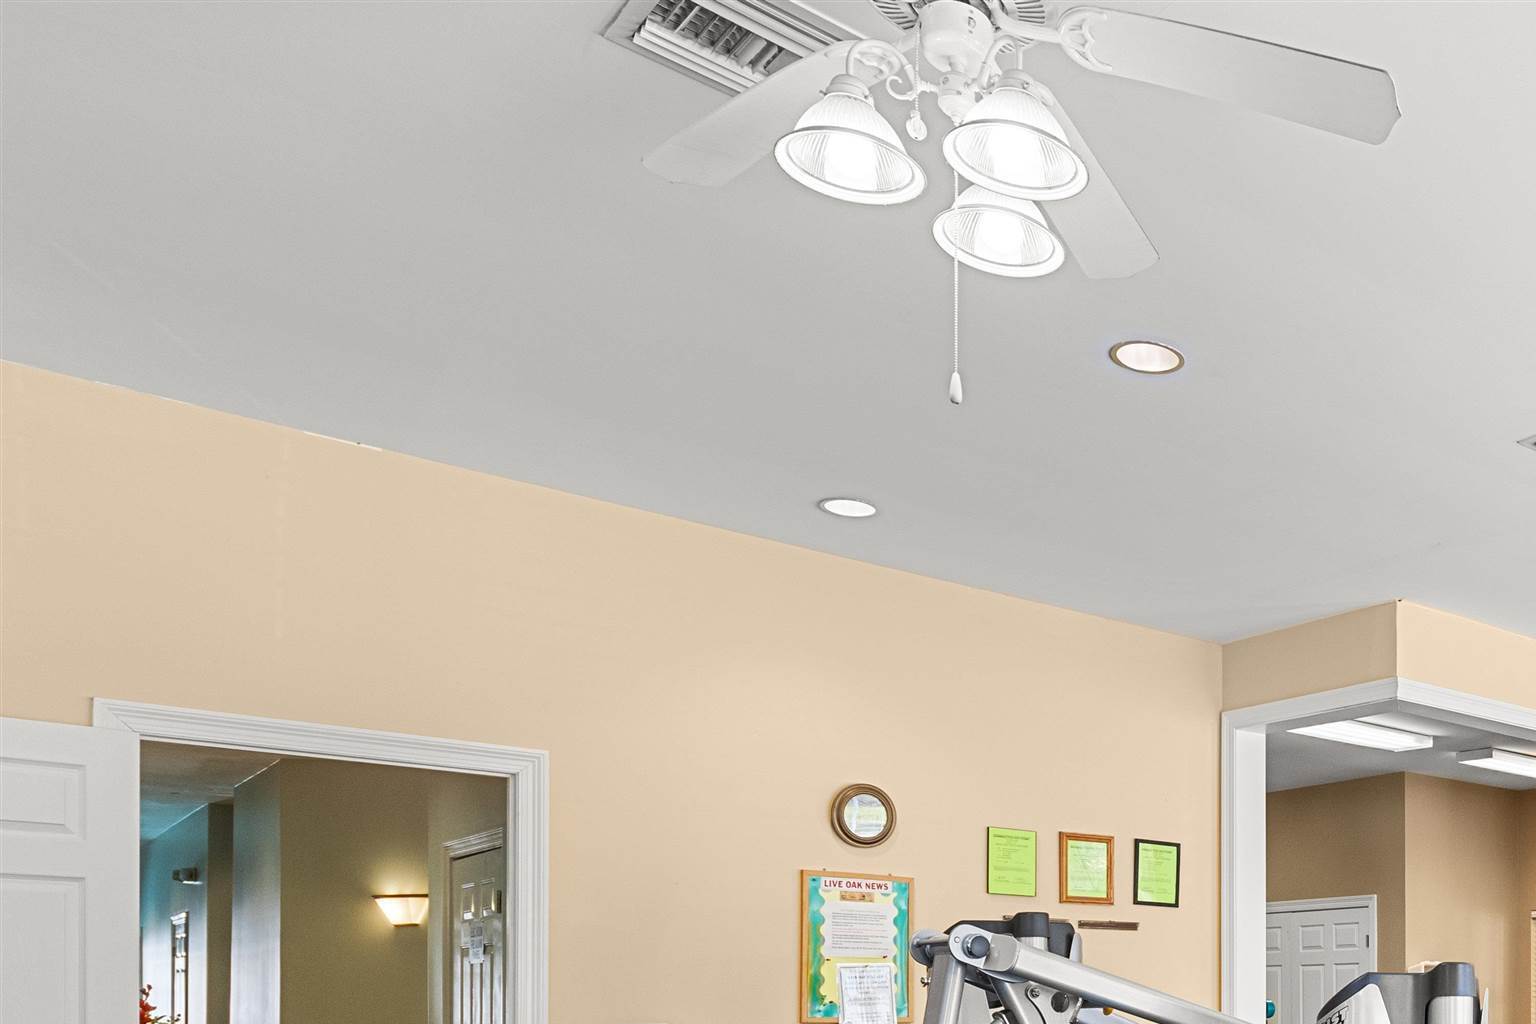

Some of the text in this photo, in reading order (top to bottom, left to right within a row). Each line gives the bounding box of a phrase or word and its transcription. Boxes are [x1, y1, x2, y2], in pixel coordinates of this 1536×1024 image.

[823, 879, 889, 891] LIVE OAK NEWS
